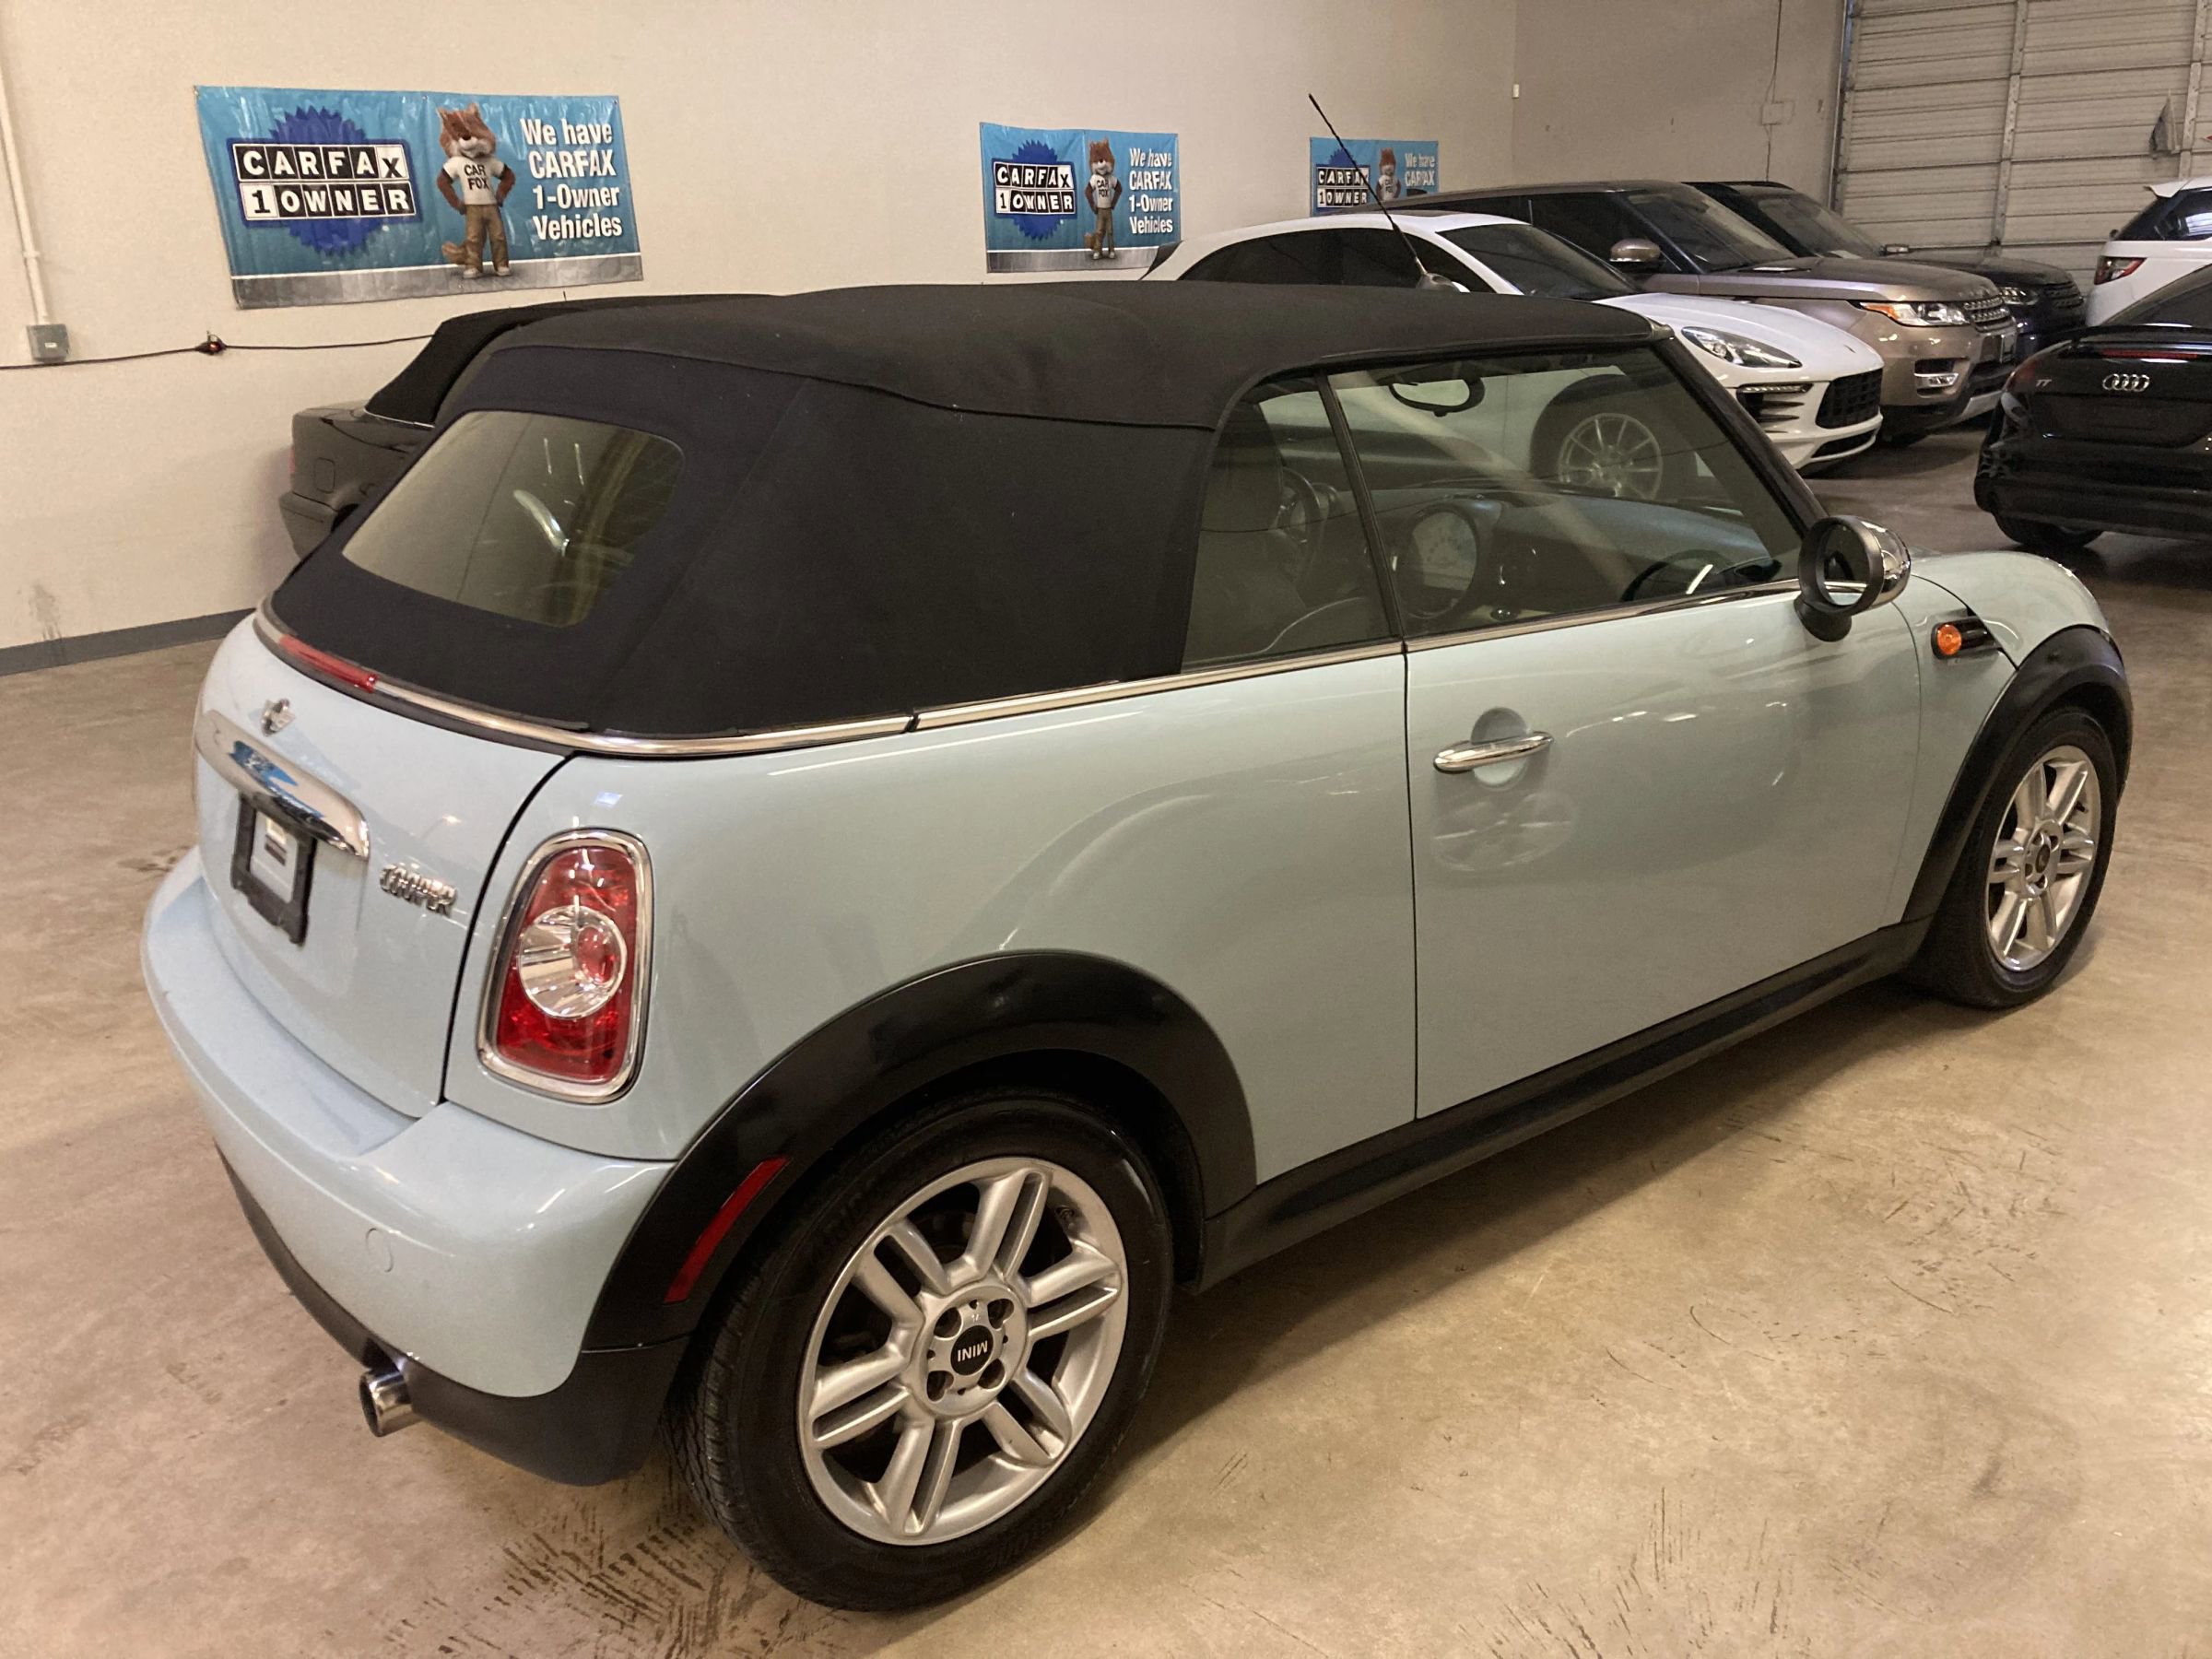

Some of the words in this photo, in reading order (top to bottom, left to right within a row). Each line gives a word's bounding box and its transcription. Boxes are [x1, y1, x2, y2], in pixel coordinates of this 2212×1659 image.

[520, 118, 557, 146] We
[560, 118, 613, 146] have
[242, 149, 402, 178] CARFAX
[528, 149, 617, 179] CARFAX
[1129, 147, 1147, 167] We
[1147, 147, 1172, 168] have
[464, 164, 487, 176] CAR
[997, 165, 1072, 188] CARFAX
[1129, 170, 1172, 191] CARFAX
[468, 178, 490, 190] FOX
[532, 182, 620, 210] 1-Owner
[1129, 194, 1173, 213] 1-Owner
[532, 213, 623, 241] Vehicles
[1129, 215, 1173, 234] Vehicles
[958, 1340, 988, 1362] MINI
